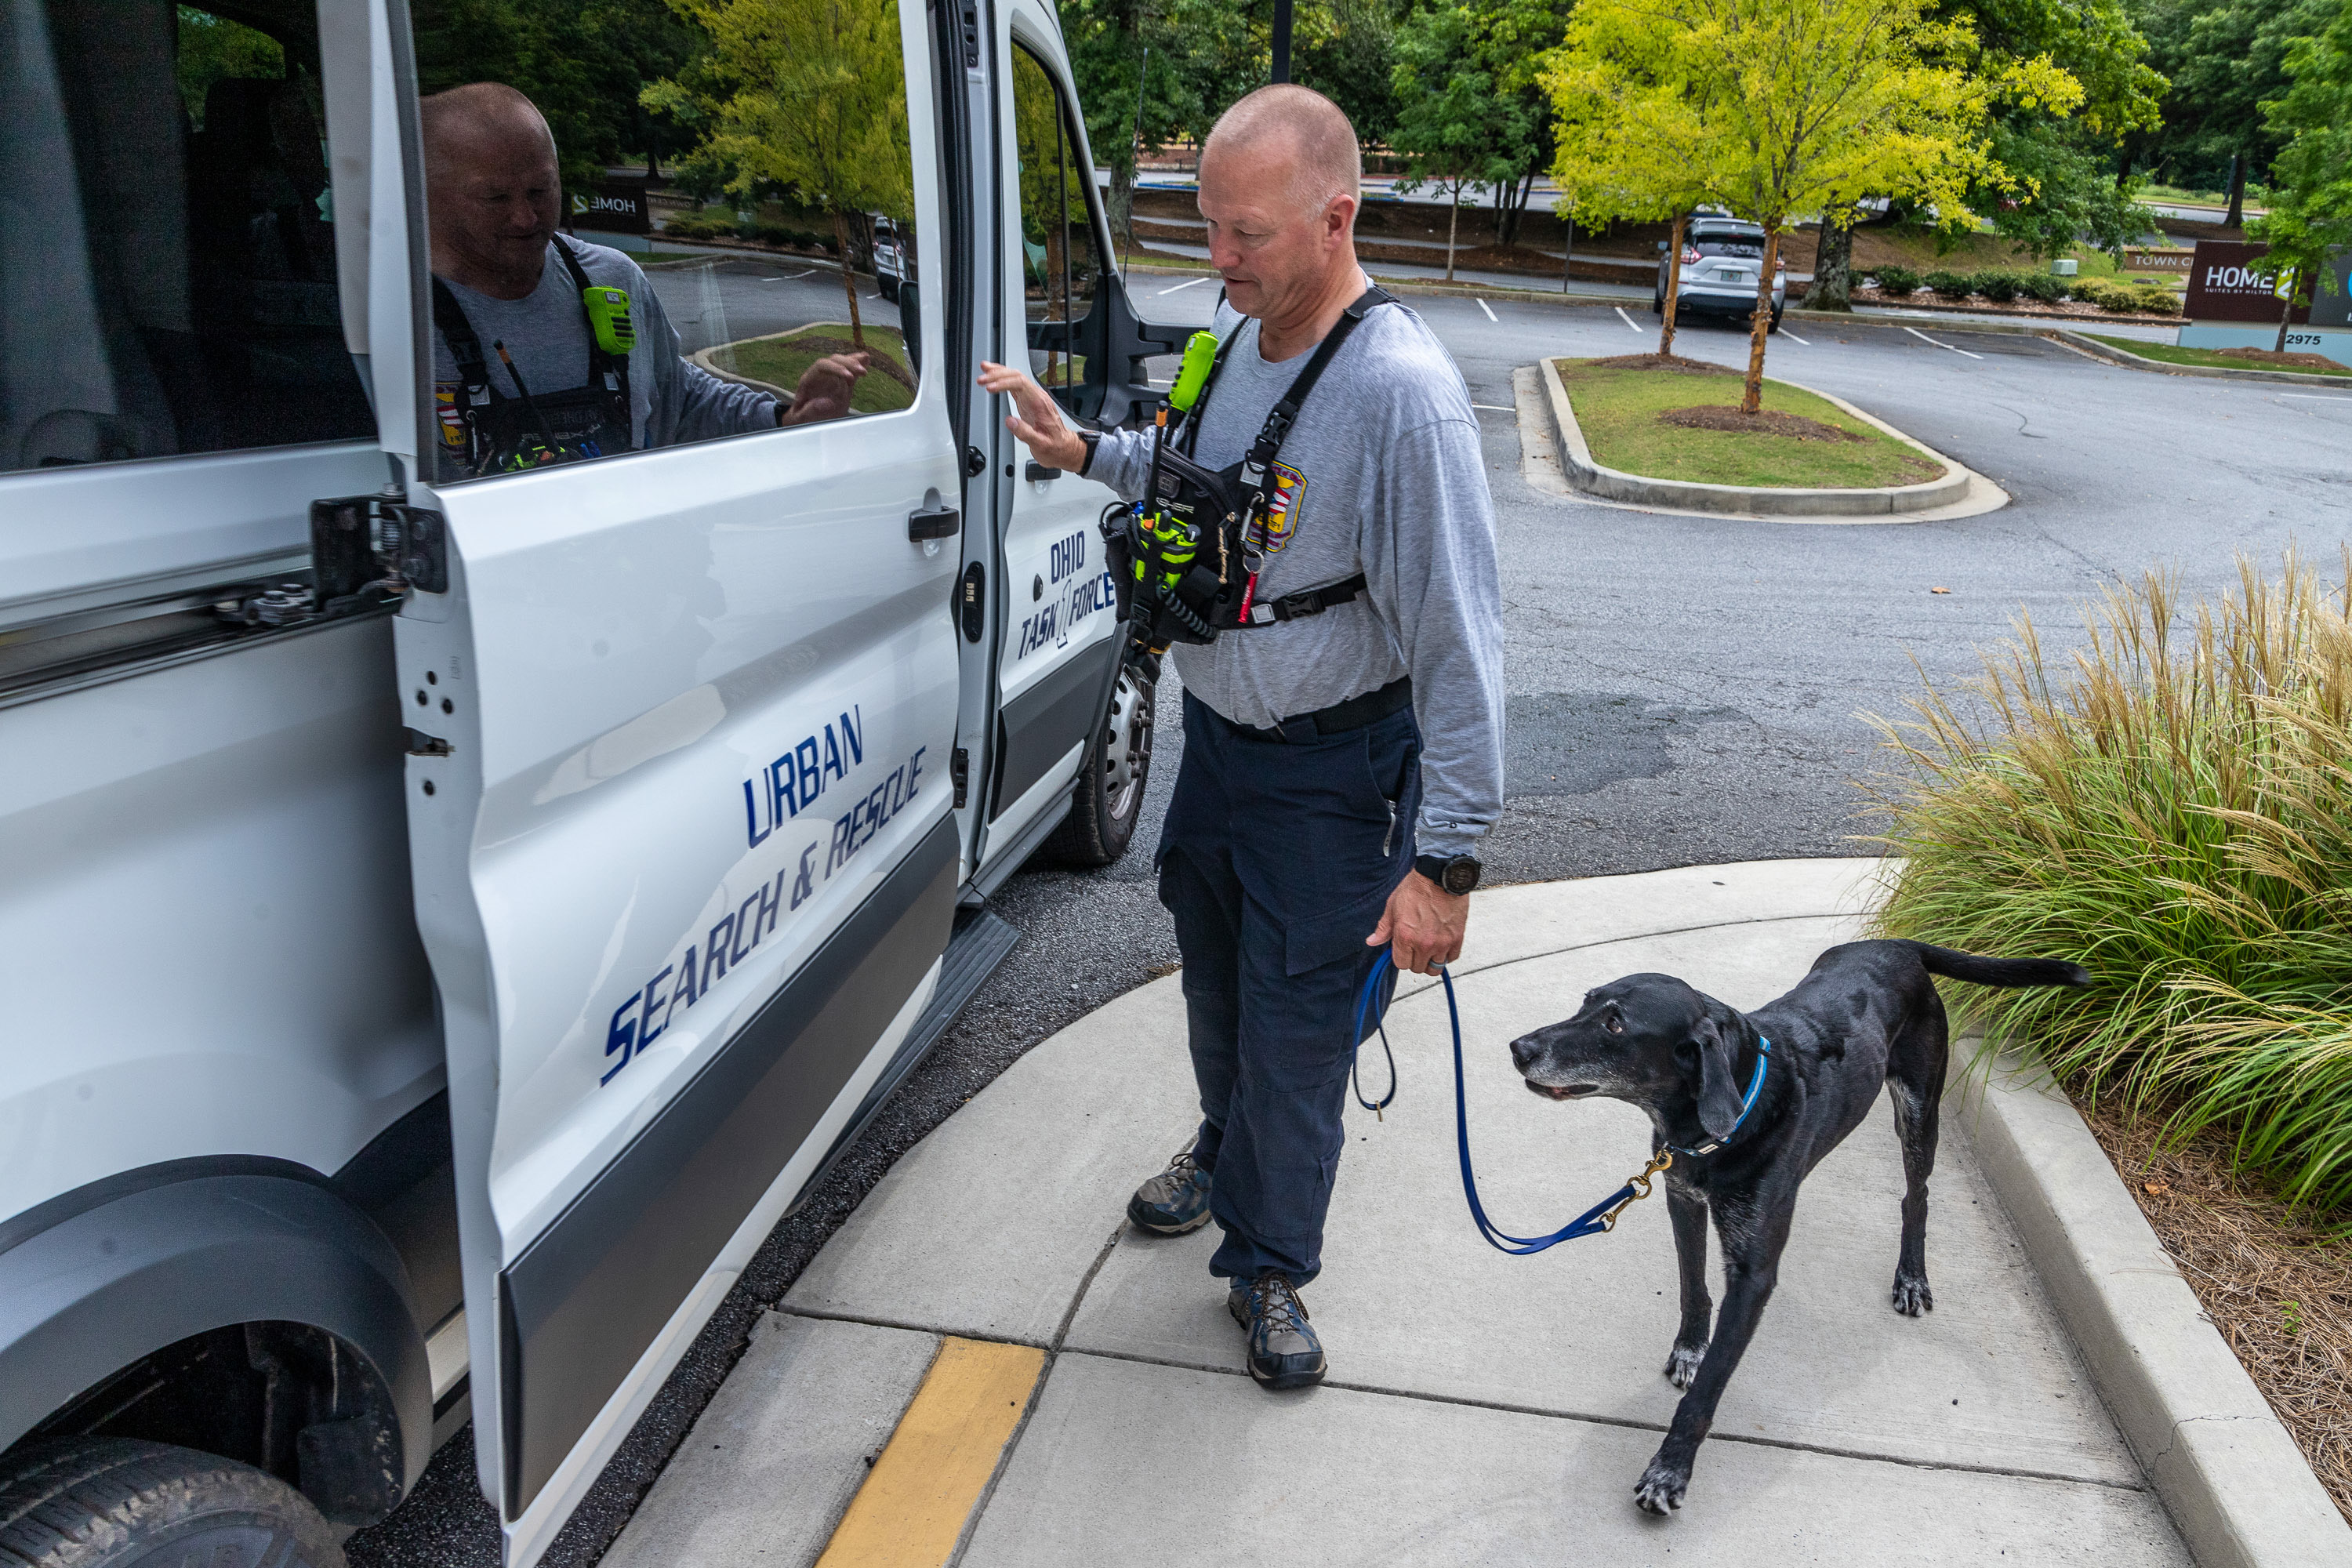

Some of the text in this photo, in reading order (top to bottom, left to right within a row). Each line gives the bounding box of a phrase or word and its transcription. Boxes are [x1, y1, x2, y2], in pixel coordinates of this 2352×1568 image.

[2135, 256, 2177, 266] TOWN
[2285, 335, 2321, 346] 2975
[1051, 530, 1085, 585] OHIO
[1018, 600, 1060, 661] TASK
[1069, 571, 1116, 627] FORCE
[742, 704, 863, 850] URBAN
[599, 745, 927, 1088] SEARCH & RESCUE
